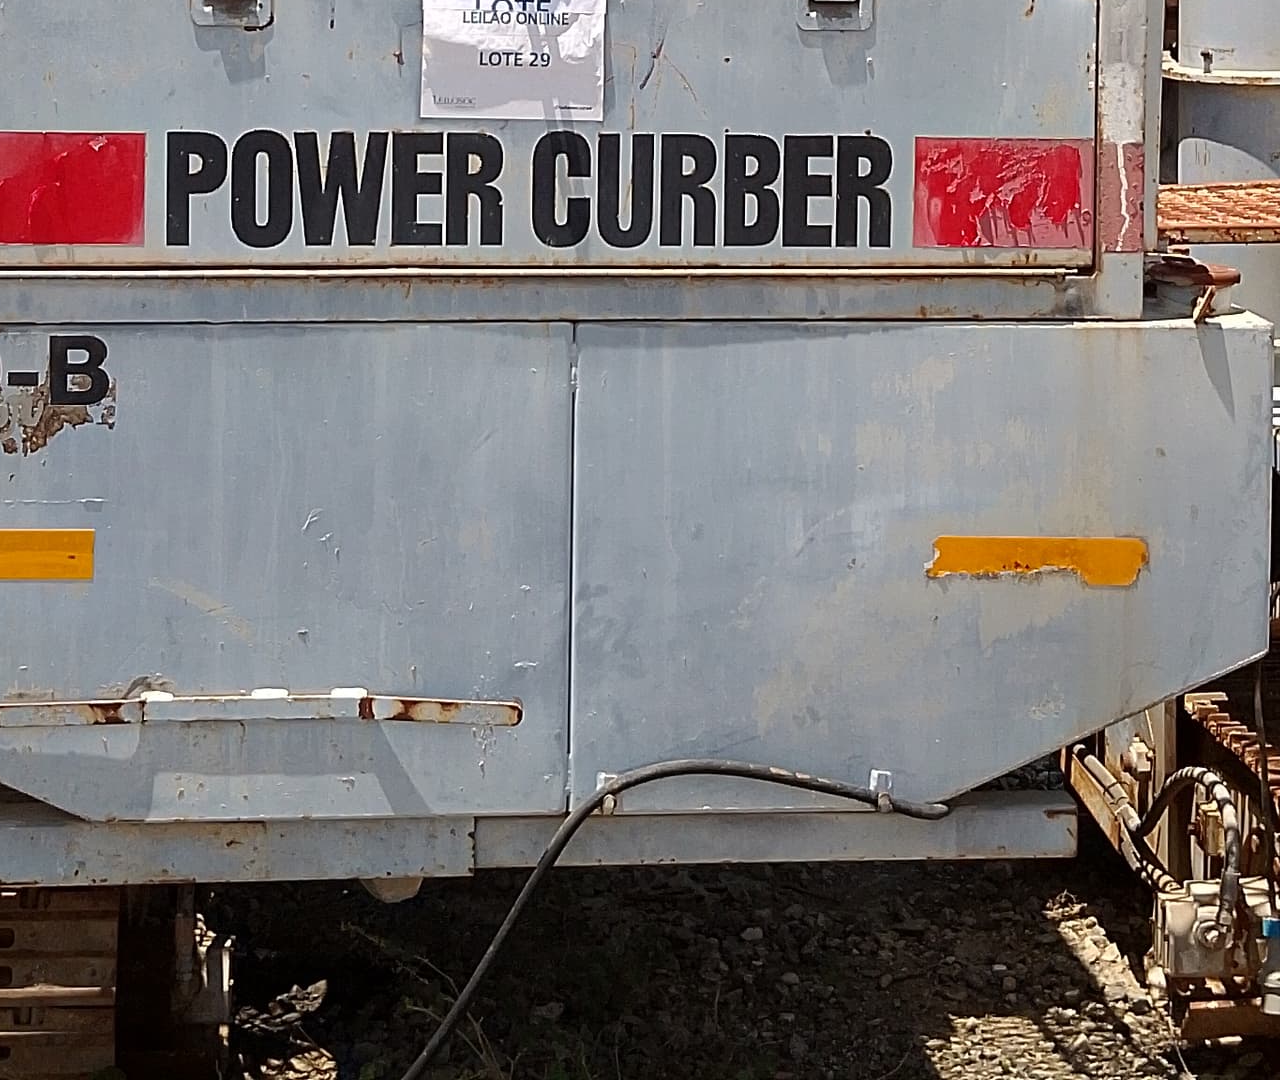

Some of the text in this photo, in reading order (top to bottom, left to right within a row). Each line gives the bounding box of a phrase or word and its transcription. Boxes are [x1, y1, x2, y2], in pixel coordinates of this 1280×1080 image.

[516, 11, 569, 26] ONLINE
[479, 51, 551, 67] LOTE 29
[166, 130, 894, 248] POWER CURBER
